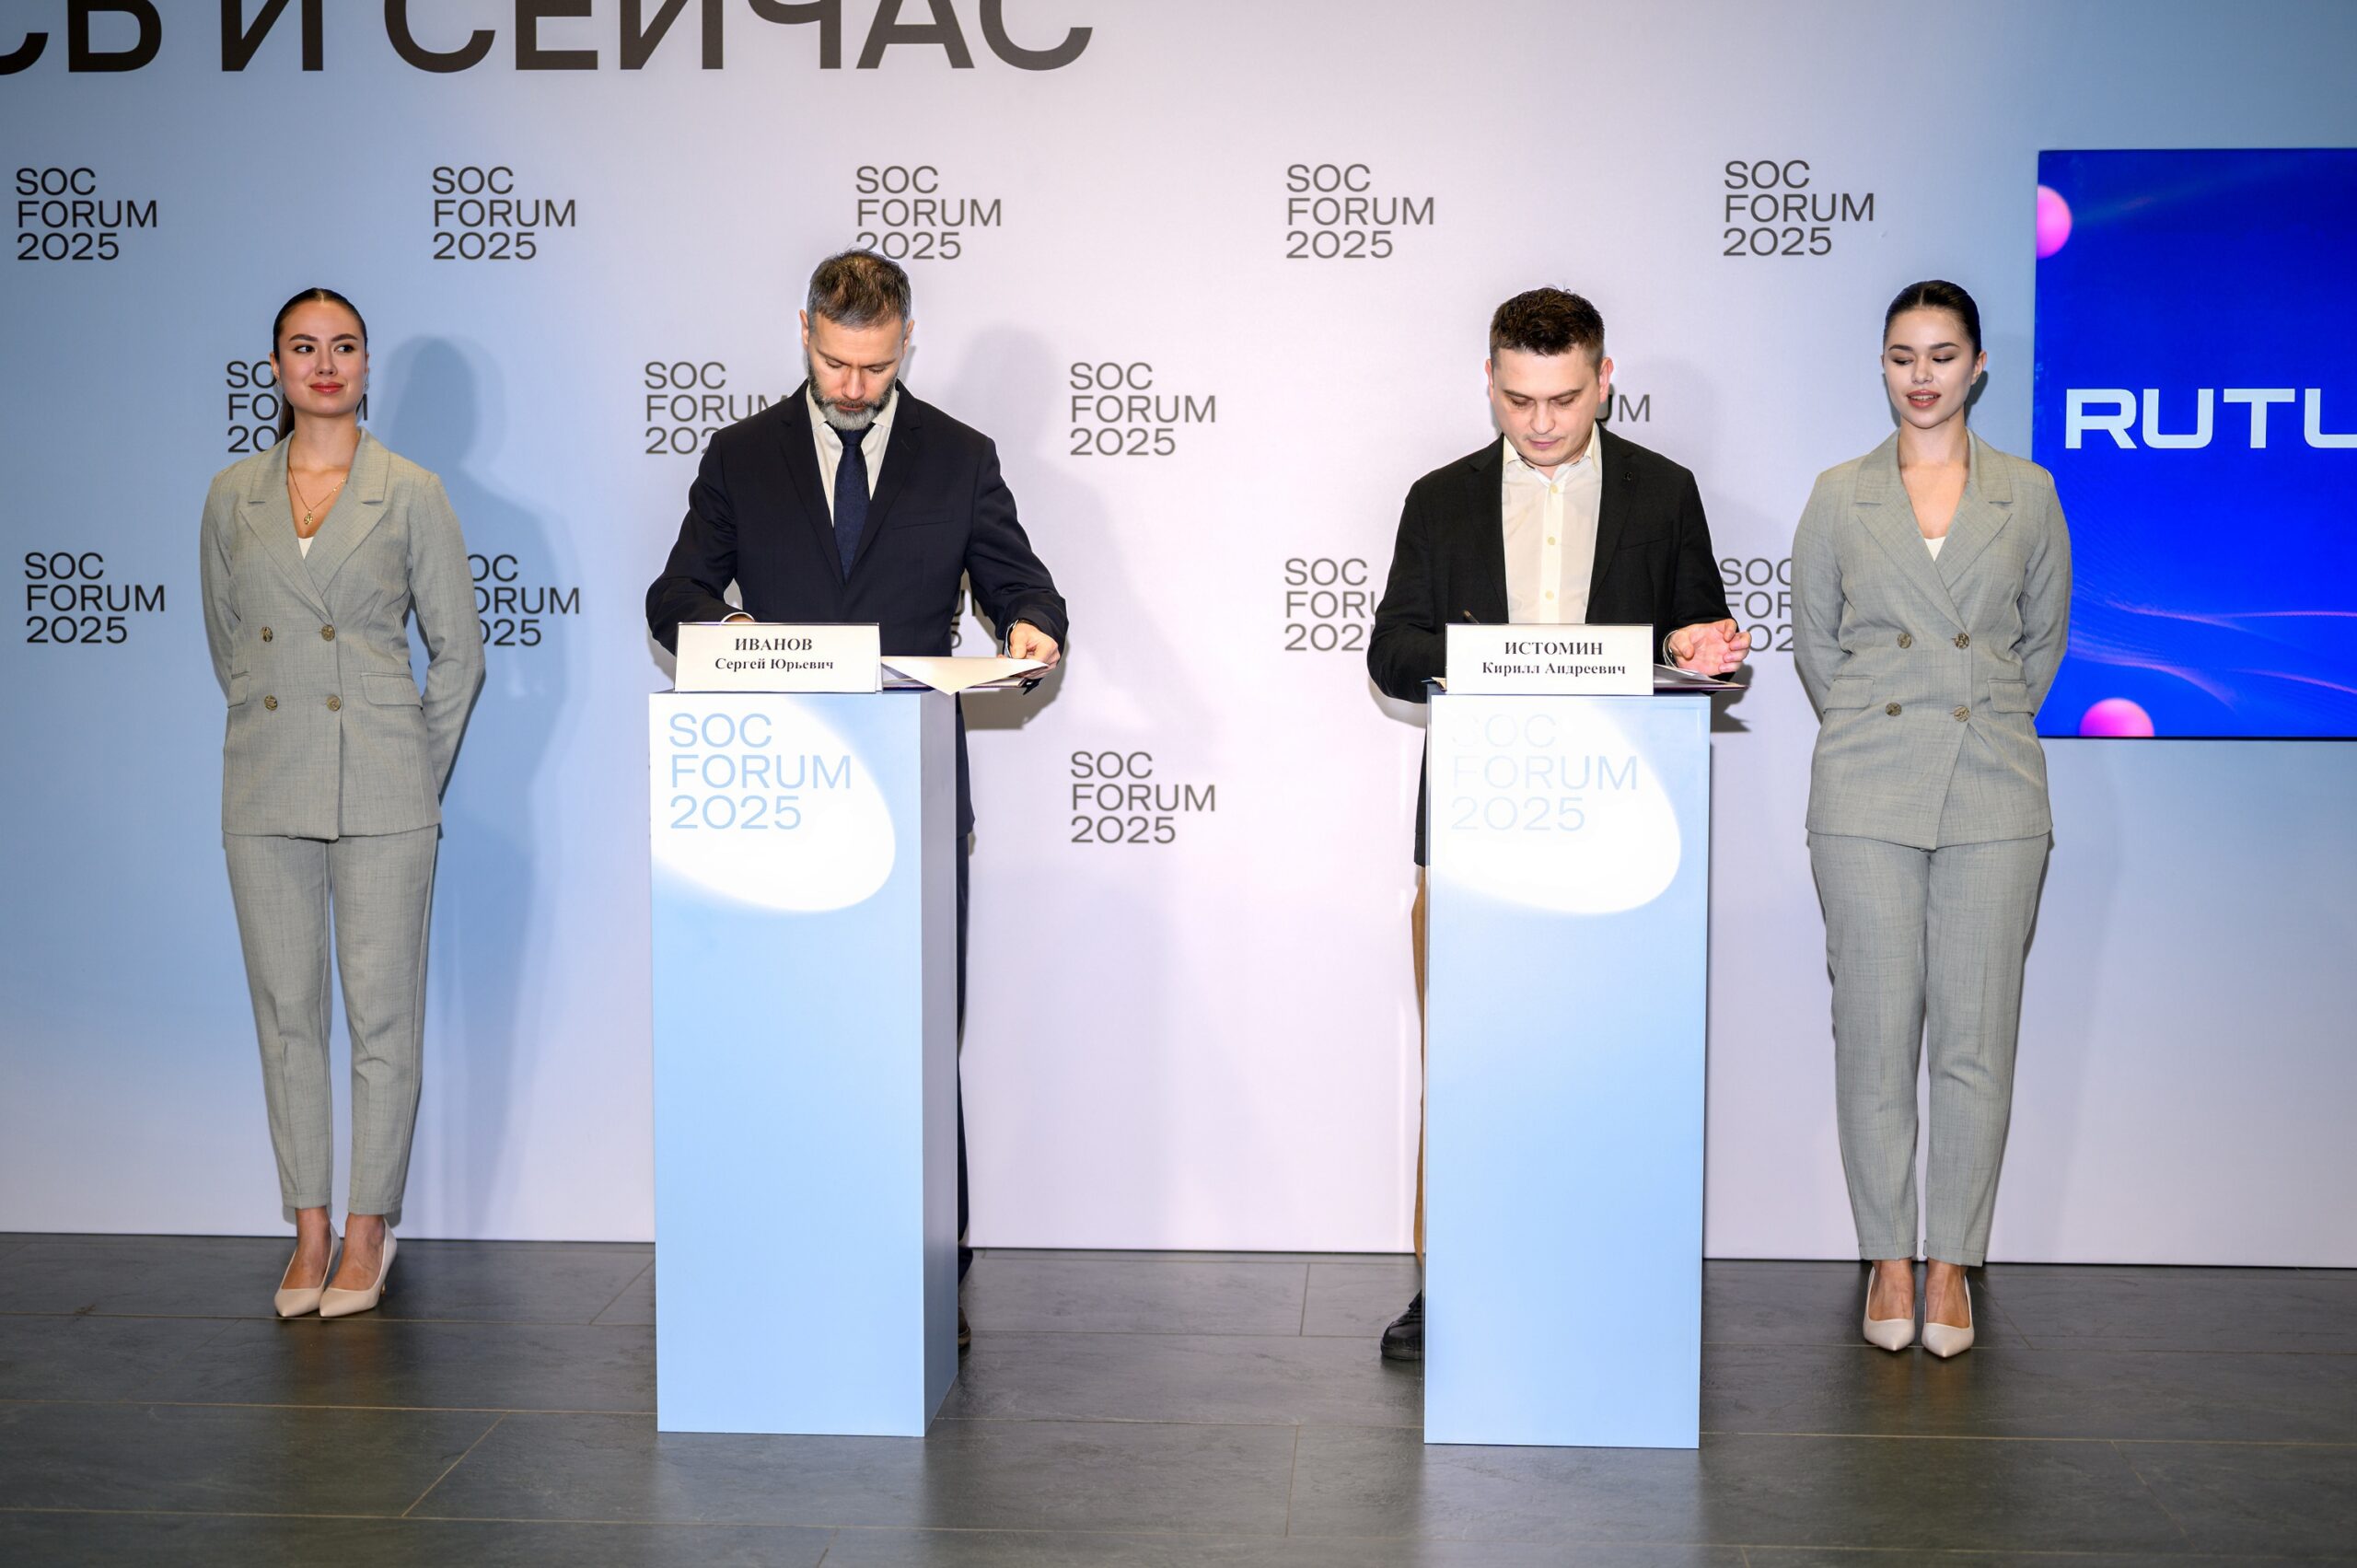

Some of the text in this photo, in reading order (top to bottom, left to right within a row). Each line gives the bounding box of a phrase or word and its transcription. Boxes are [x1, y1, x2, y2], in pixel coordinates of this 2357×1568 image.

[0, 0, 162, 75] Ь
[16, 168, 96, 195] SOC
[433, 167, 513, 194] SOC
[856, 166, 938, 193] SOC
[1287, 164, 1370, 192] SOC
[1724, 160, 1809, 189] SOC
[18, 201, 157, 227] FORUM
[435, 199, 575, 227] FORUM
[858, 199, 1001, 226] FORUM
[1289, 197, 1434, 226] FORUM
[1726, 193, 1874, 222] FORUM
[17, 233, 119, 261] 2025
[434, 232, 536, 260] 2025
[1286, 230, 1392, 259] 2025
[1724, 227, 1831, 256] 2025
[226, 361, 278, 389] SO
[644, 362, 726, 389] SOC
[1070, 363, 1152, 390] SOC
[1072, 395, 1215, 424] FORUM
[227, 425, 279, 453] 20
[645, 426, 720, 455] 20
[1071, 428, 1176, 457] 2025
[24, 552, 103, 580] SOC
[468, 554, 518, 582] OC
[1284, 558, 1368, 587] SOC
[27, 585, 164, 612] FORUM
[474, 587, 579, 614] ORUM
[1286, 591, 1376, 619] FOR
[26, 616, 128, 644] 2025
[480, 619, 541, 646] 25
[1284, 623, 1376, 652] 202
[1747, 624, 1794, 652] 02
[735, 638, 813, 652] ИВАНОВ
[1504, 642, 1603, 656] ИСТОМИН
[714, 657, 834, 672] Сергей Юрьевич
[1482, 662, 1626, 677] Кирилл Андреевич
[668, 713, 772, 748] SOC
[671, 754, 852, 789] FORUM
[1071, 751, 1153, 779] SOC
[1453, 754, 1638, 790] FORUM
[1073, 784, 1214, 812] FORUM
[670, 795, 802, 830] 2025
[1451, 796, 1585, 831] 2025
[1072, 816, 1176, 843] 2025
